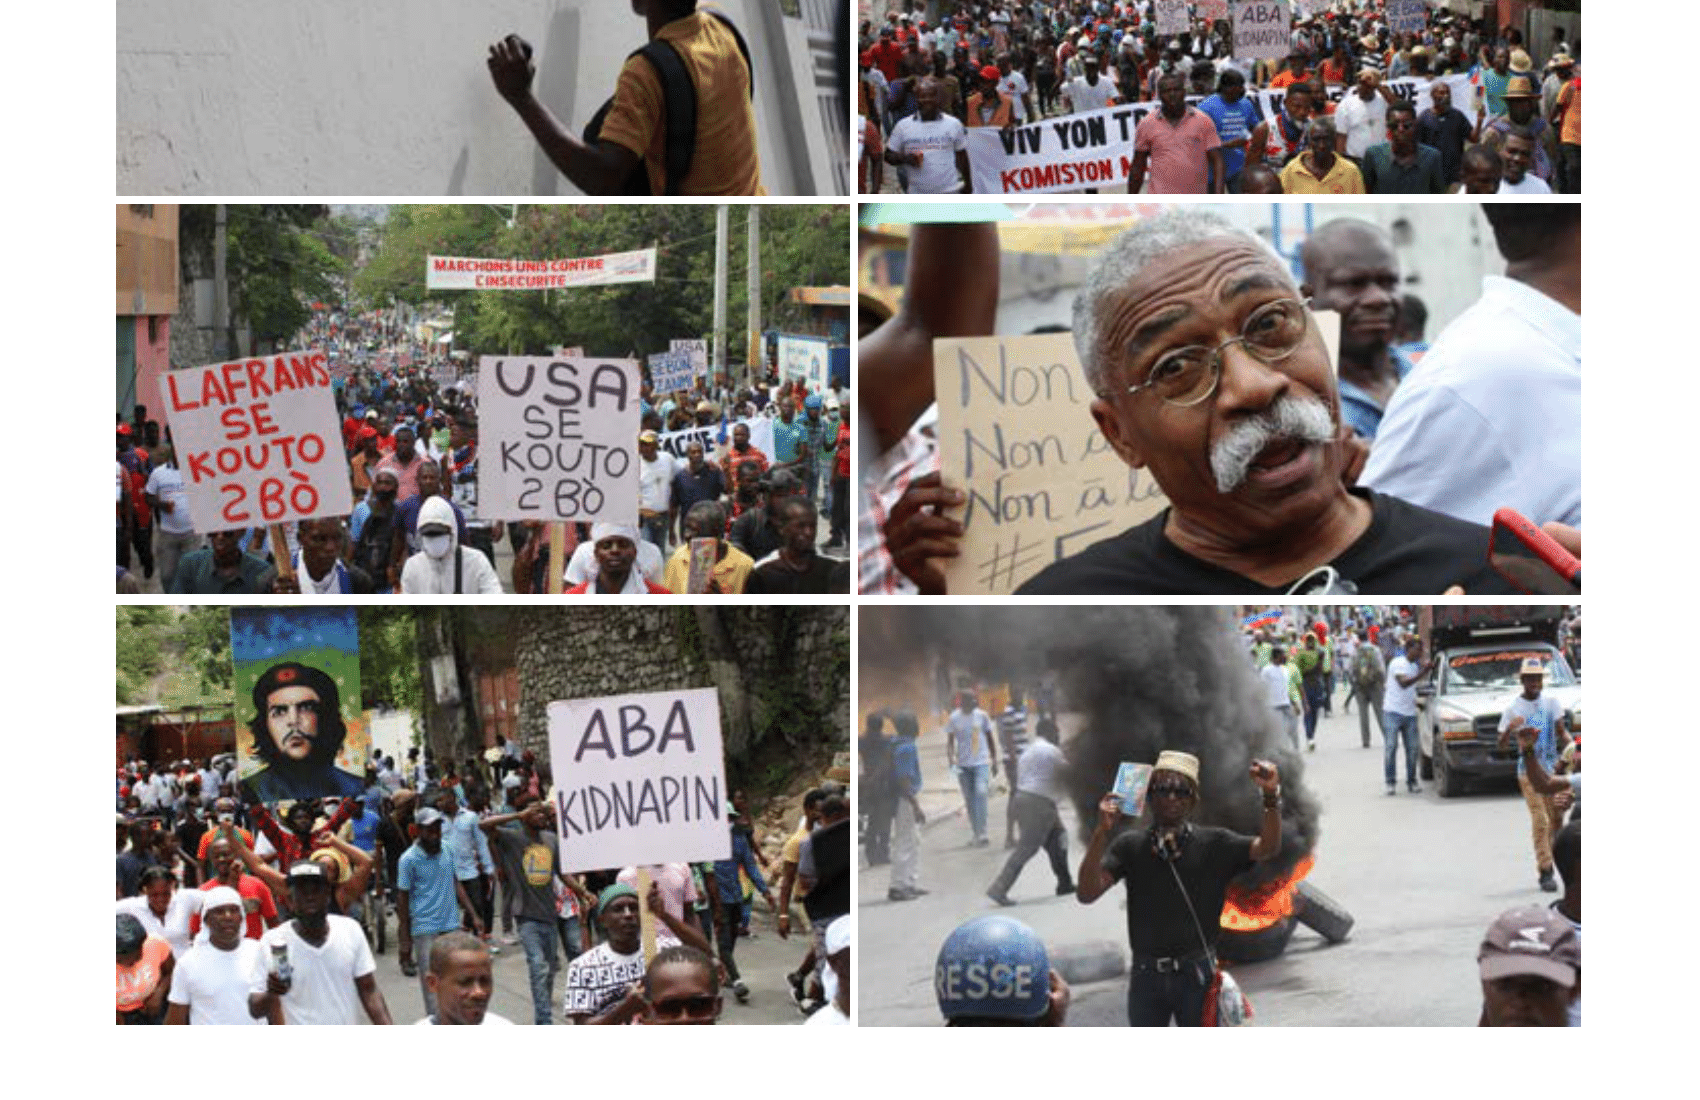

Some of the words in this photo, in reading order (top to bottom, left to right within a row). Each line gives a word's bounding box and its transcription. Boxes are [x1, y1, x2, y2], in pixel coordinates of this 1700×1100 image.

[1241, 4, 1283, 24] ABA
[999, 125, 1042, 156] VIV
[1053, 114, 1107, 151] YON
[1001, 157, 1114, 193] KOMISYON
[516, 257, 548, 273] UNIS
[551, 258, 605, 272] CONTRE
[167, 353, 331, 413] LAFRANS
[495, 360, 628, 412] USA
[958, 344, 1079, 408] Non
[220, 402, 280, 441] SE
[523, 404, 584, 440] SE
[187, 432, 326, 484] KOUTO
[501, 441, 630, 480] KOUTO
[964, 423, 1068, 479] Non
[220, 483, 250, 523] 2
[259, 470, 320, 522] BÒ
[518, 477, 544, 510] 2
[554, 477, 605, 518] BÒ
[964, 472, 1064, 528] Non
[574, 699, 696, 763] ABA
[558, 775, 719, 839] KIDNAPIN
